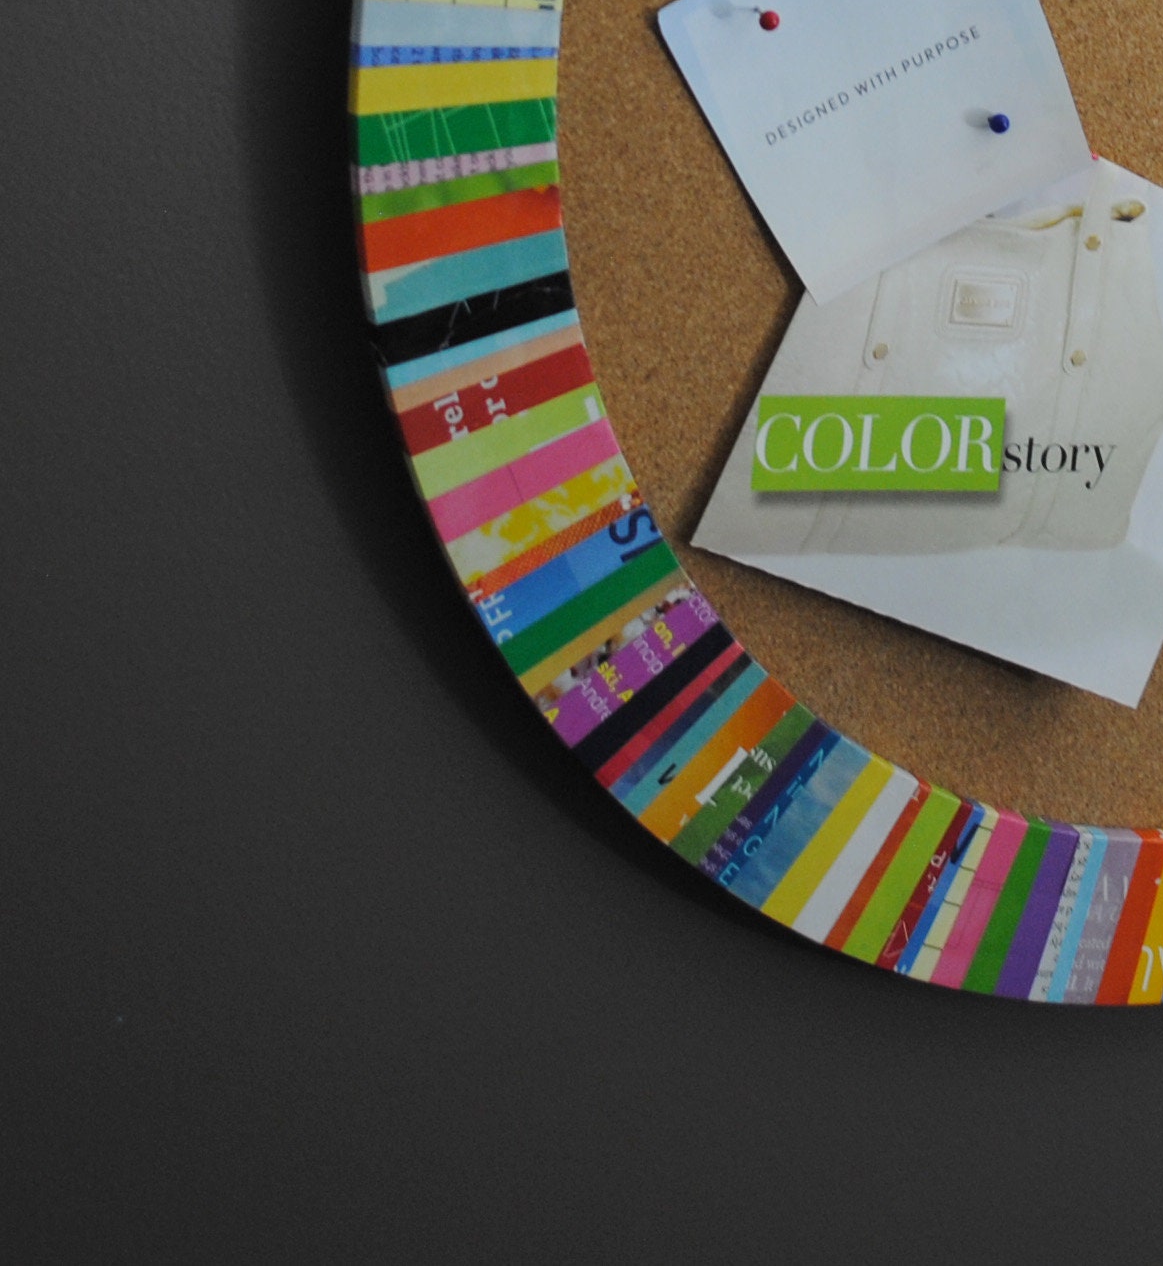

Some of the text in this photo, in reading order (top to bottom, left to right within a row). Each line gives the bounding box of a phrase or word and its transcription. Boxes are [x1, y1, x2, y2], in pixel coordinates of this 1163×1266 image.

[764, 24, 982, 147] DESIGNED WITH PURPOSE
[755, 412, 1118, 490] COLOR story
